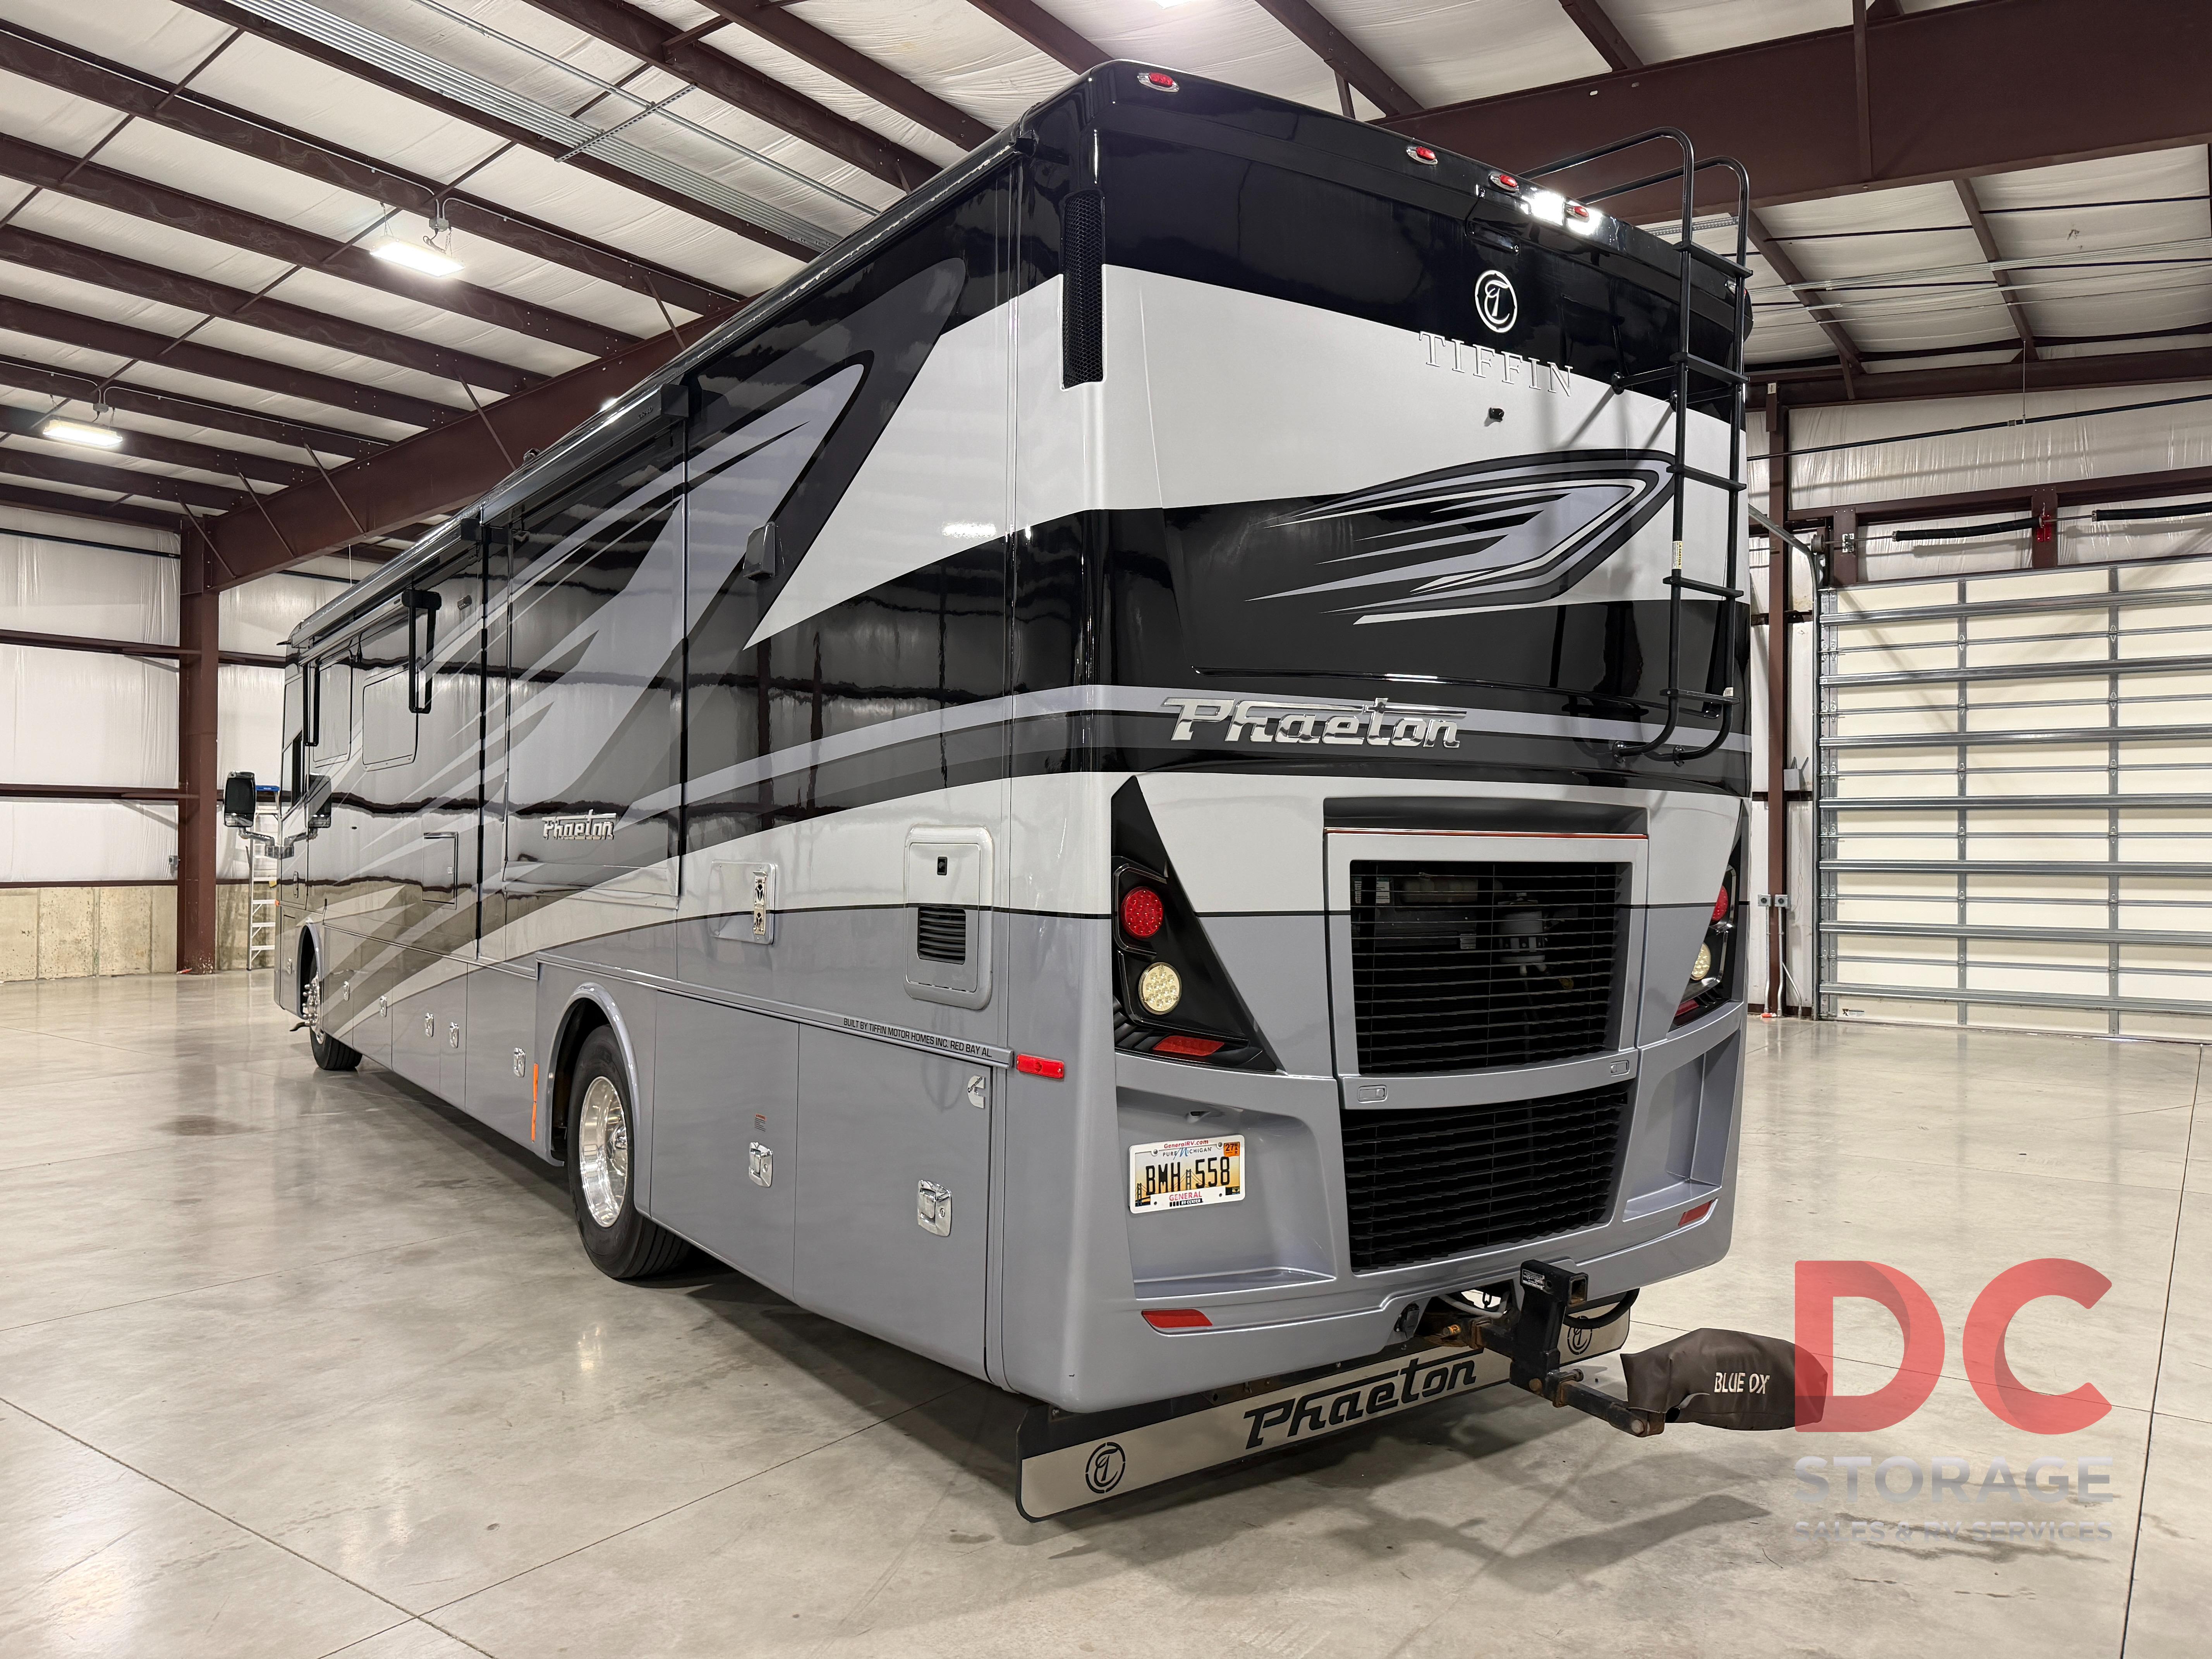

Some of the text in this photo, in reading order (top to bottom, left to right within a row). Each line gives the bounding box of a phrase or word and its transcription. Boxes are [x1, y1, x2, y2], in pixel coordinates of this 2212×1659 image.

[1419, 331, 1573, 397] TIFFIN
[1161, 697, 1467, 748] Phaeton
[542, 809, 617, 840] Phaeton
[844, 1018, 859, 1028] BUILT
[860, 1021, 868, 1030] BY
[869, 1023, 886, 1035] TIFFIN
[888, 1027, 910, 1039] MOTOR
[911, 1032, 934, 1045] HOMES
[936, 1037, 948, 1048] INC.
[950, 1041, 963, 1051] RED
[966, 1044, 981, 1054] BAY
[1164, 1139, 1209, 1149] GeneralRV.com
[1225, 1143, 1234, 1152] 27
[1146, 1156, 1230, 1196] BMH 558
[1169, 1191, 1202, 1201] GENERAL
[1243, 1348, 1484, 1450] Phaeton
[1714, 1372, 1771, 1394] BLUE OX
